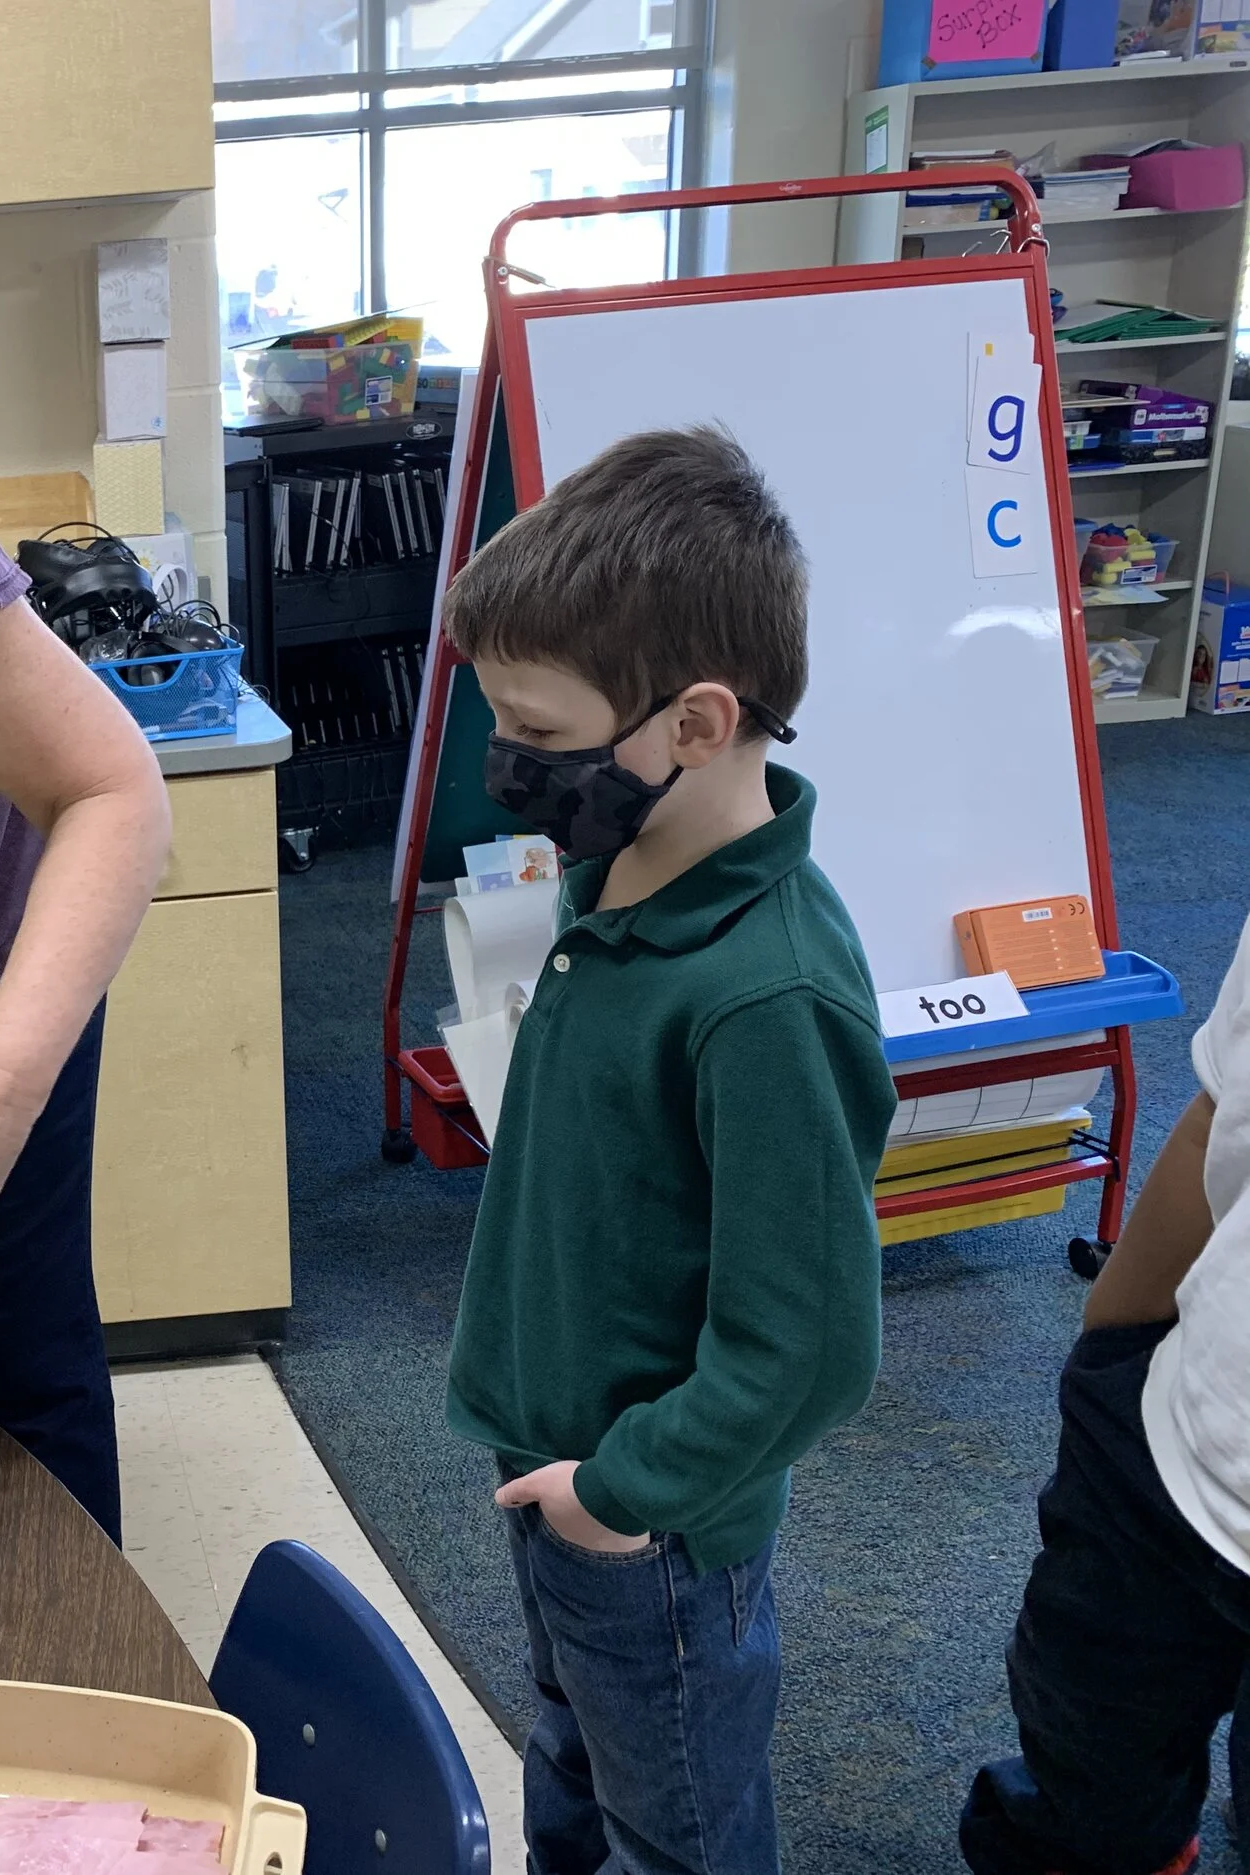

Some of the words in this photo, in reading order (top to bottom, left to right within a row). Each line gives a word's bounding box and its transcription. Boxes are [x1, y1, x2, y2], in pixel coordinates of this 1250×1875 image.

[976, 3, 1022, 49] Box
[988, 395, 1025, 462] g
[919, 994, 986, 1024] too
